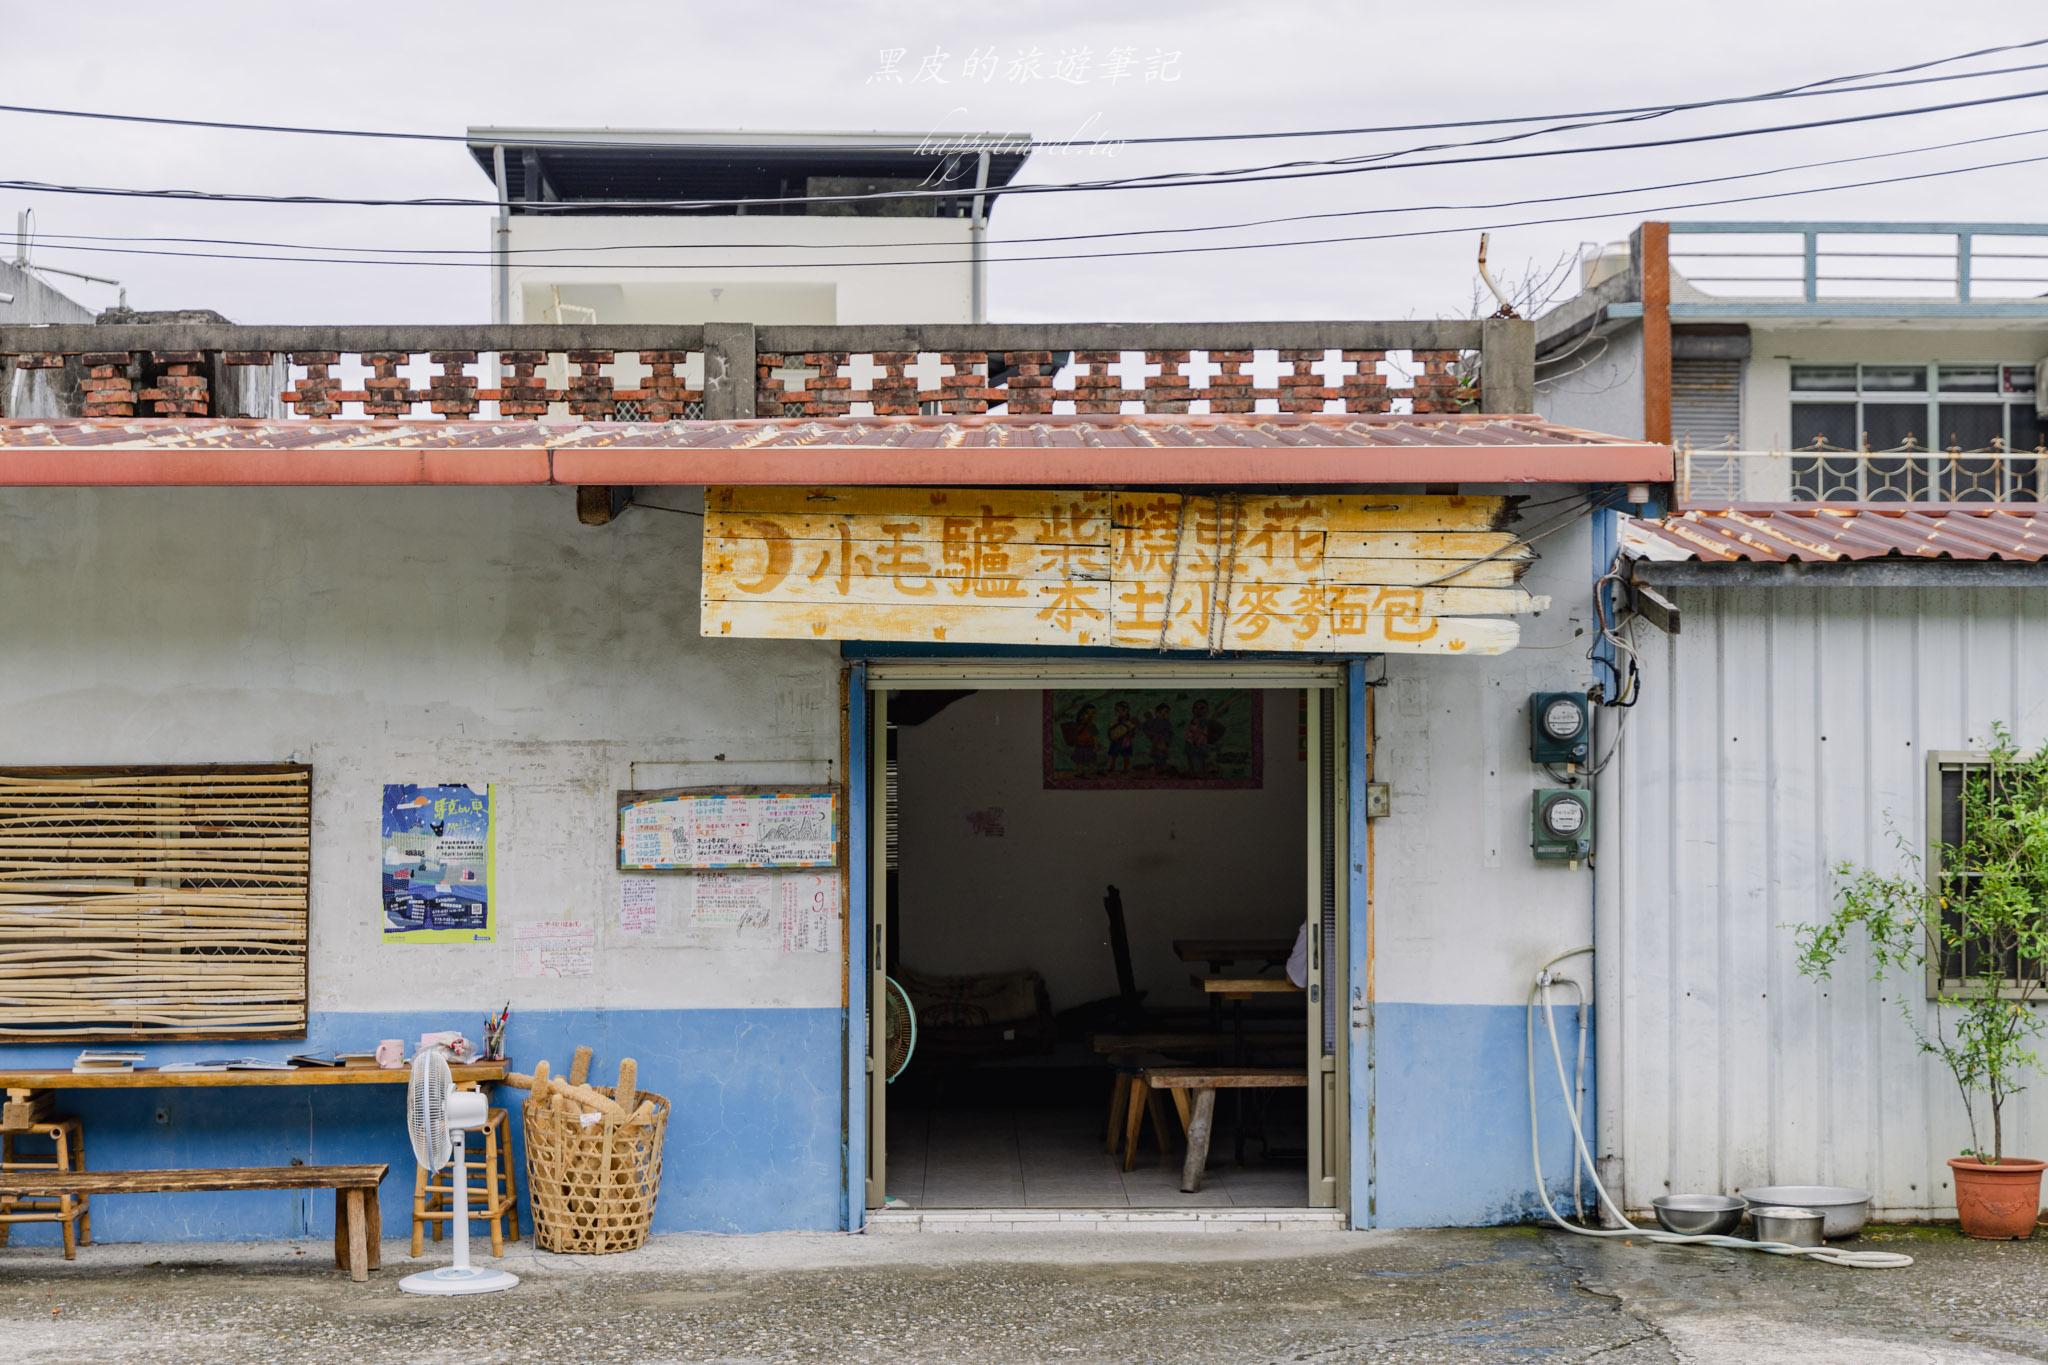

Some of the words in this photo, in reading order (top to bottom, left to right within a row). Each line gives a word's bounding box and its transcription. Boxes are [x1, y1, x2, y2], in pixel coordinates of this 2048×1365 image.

[1036, 576, 1439, 642] 本土小麥麵包
